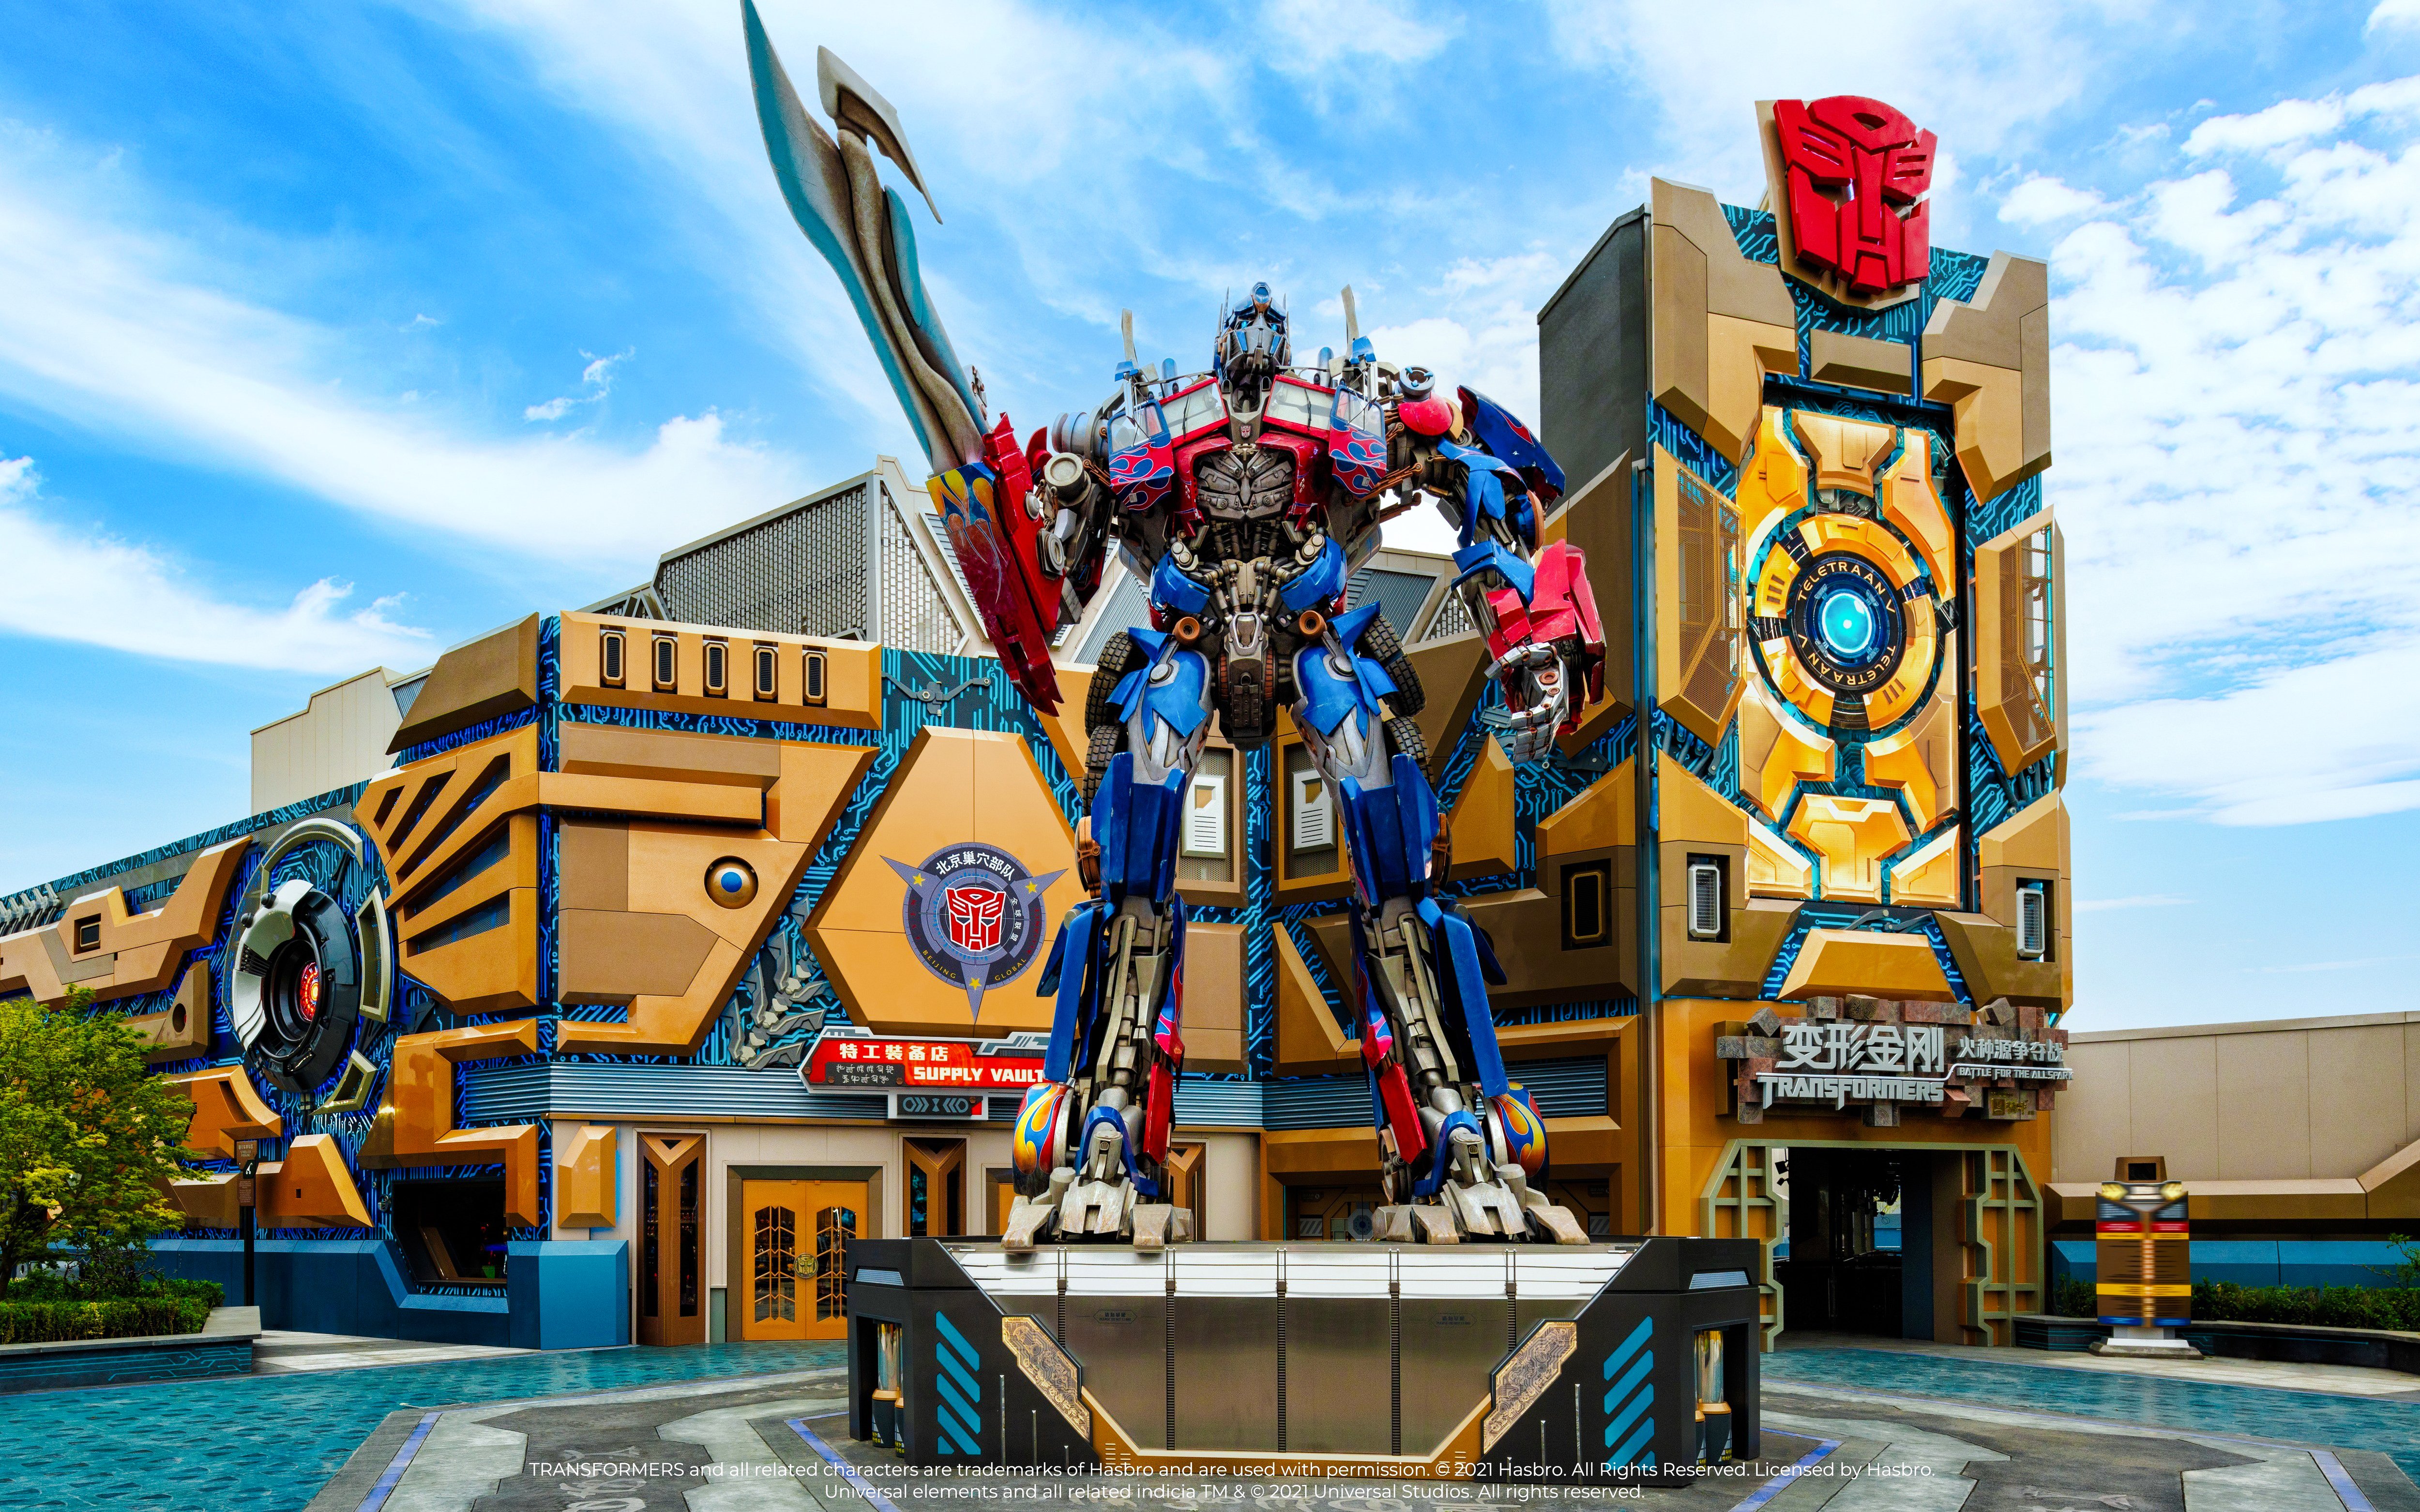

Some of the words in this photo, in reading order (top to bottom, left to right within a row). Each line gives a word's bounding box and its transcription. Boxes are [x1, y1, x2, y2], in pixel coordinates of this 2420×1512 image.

[1798, 561, 1886, 601] TELETRAAN
[1808, 645, 1896, 686] TELETRAAN
[936, 851, 1016, 881] 北京巢穴部队
[1010, 897, 1022, 942] 全球联盟
[923, 950, 956, 979] BEIJING
[995, 957, 1027, 981] GLOBAL
[839, 1043, 949, 1062] 特工装备店
[1775, 1022, 1944, 1073] 变形金刚
[1956, 1036, 2064, 1063] 火种源争夺战
[913, 1066, 983, 1081] SUPPLY
[991, 1068, 1044, 1083] VAULT
[1958, 1067, 1992, 1079] BATTLE
[1995, 1069, 2012, 1080] FOR
[2013, 1069, 2030, 1078] THE
[1757, 1077, 1945, 1110] TRANSFORMERS
